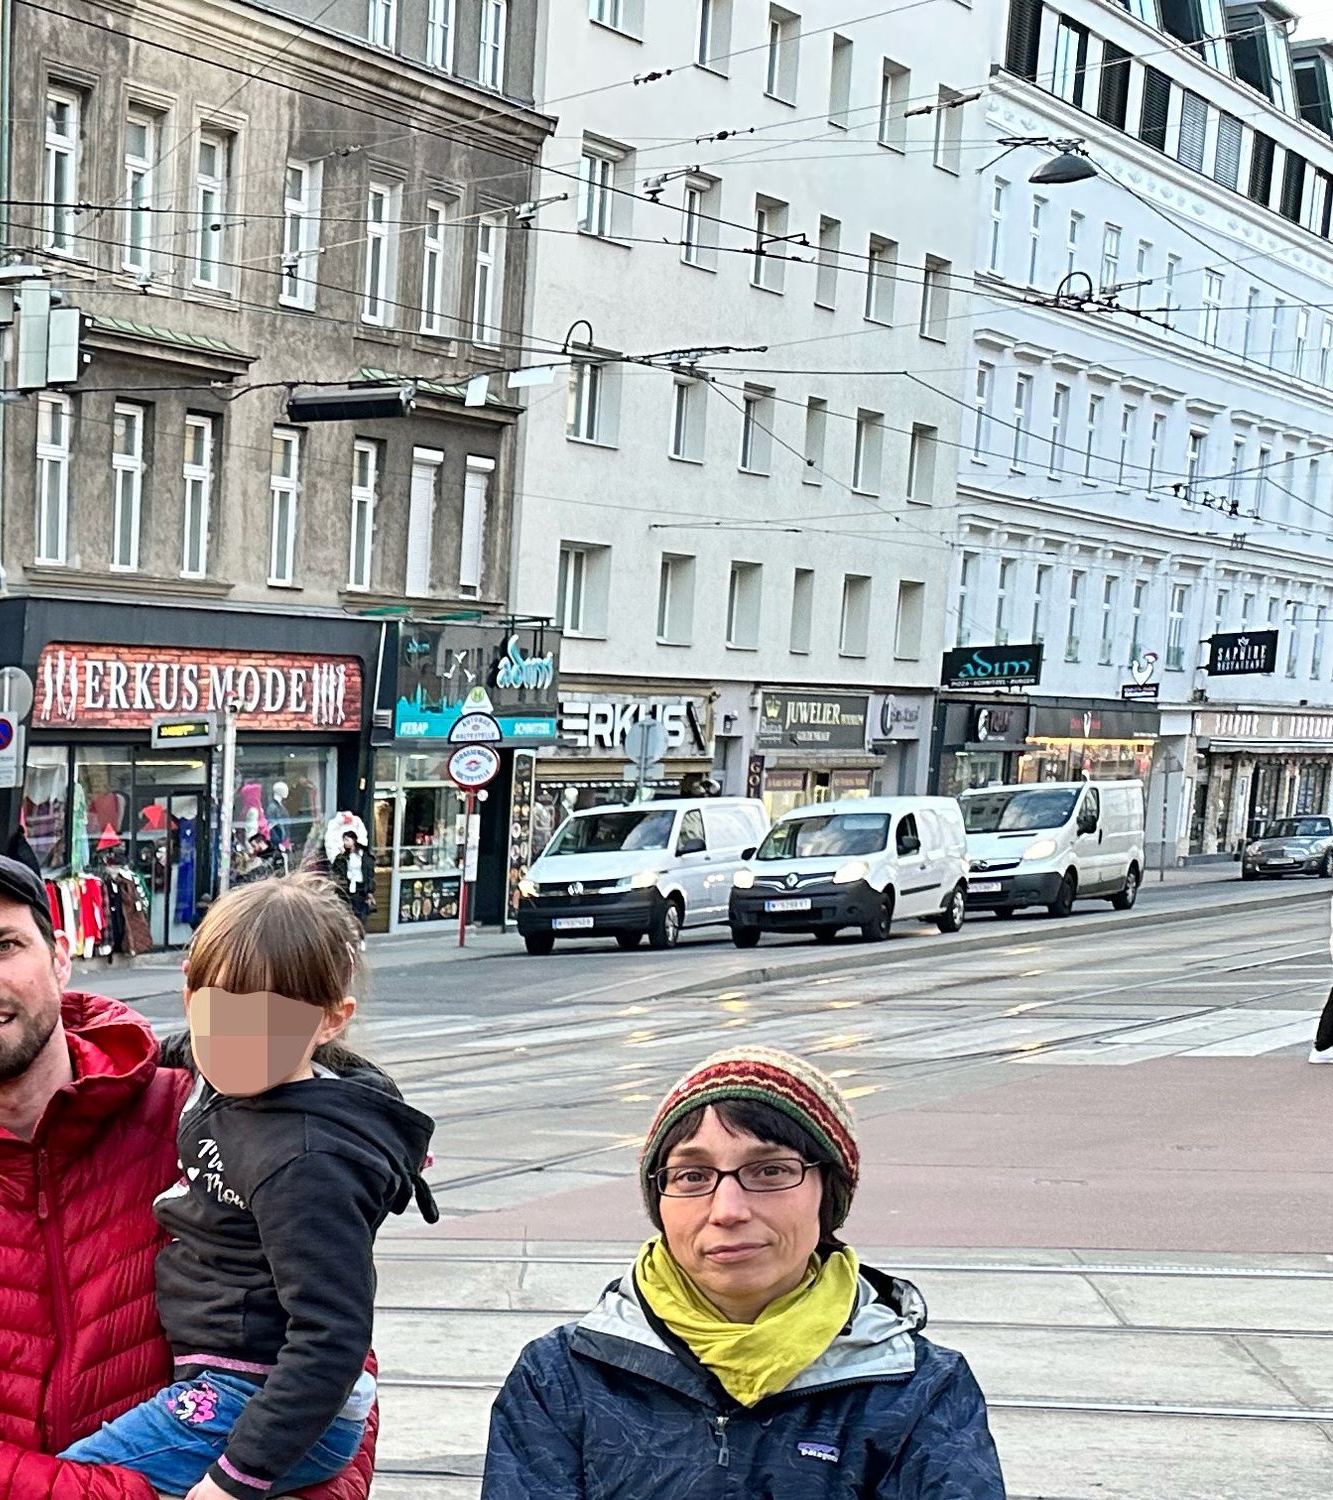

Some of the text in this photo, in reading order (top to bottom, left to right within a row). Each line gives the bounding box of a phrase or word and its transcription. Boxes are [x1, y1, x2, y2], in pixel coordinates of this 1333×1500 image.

[84, 660, 308, 713] ERKUS MODE
[785, 701, 840, 730] JUWELIER
